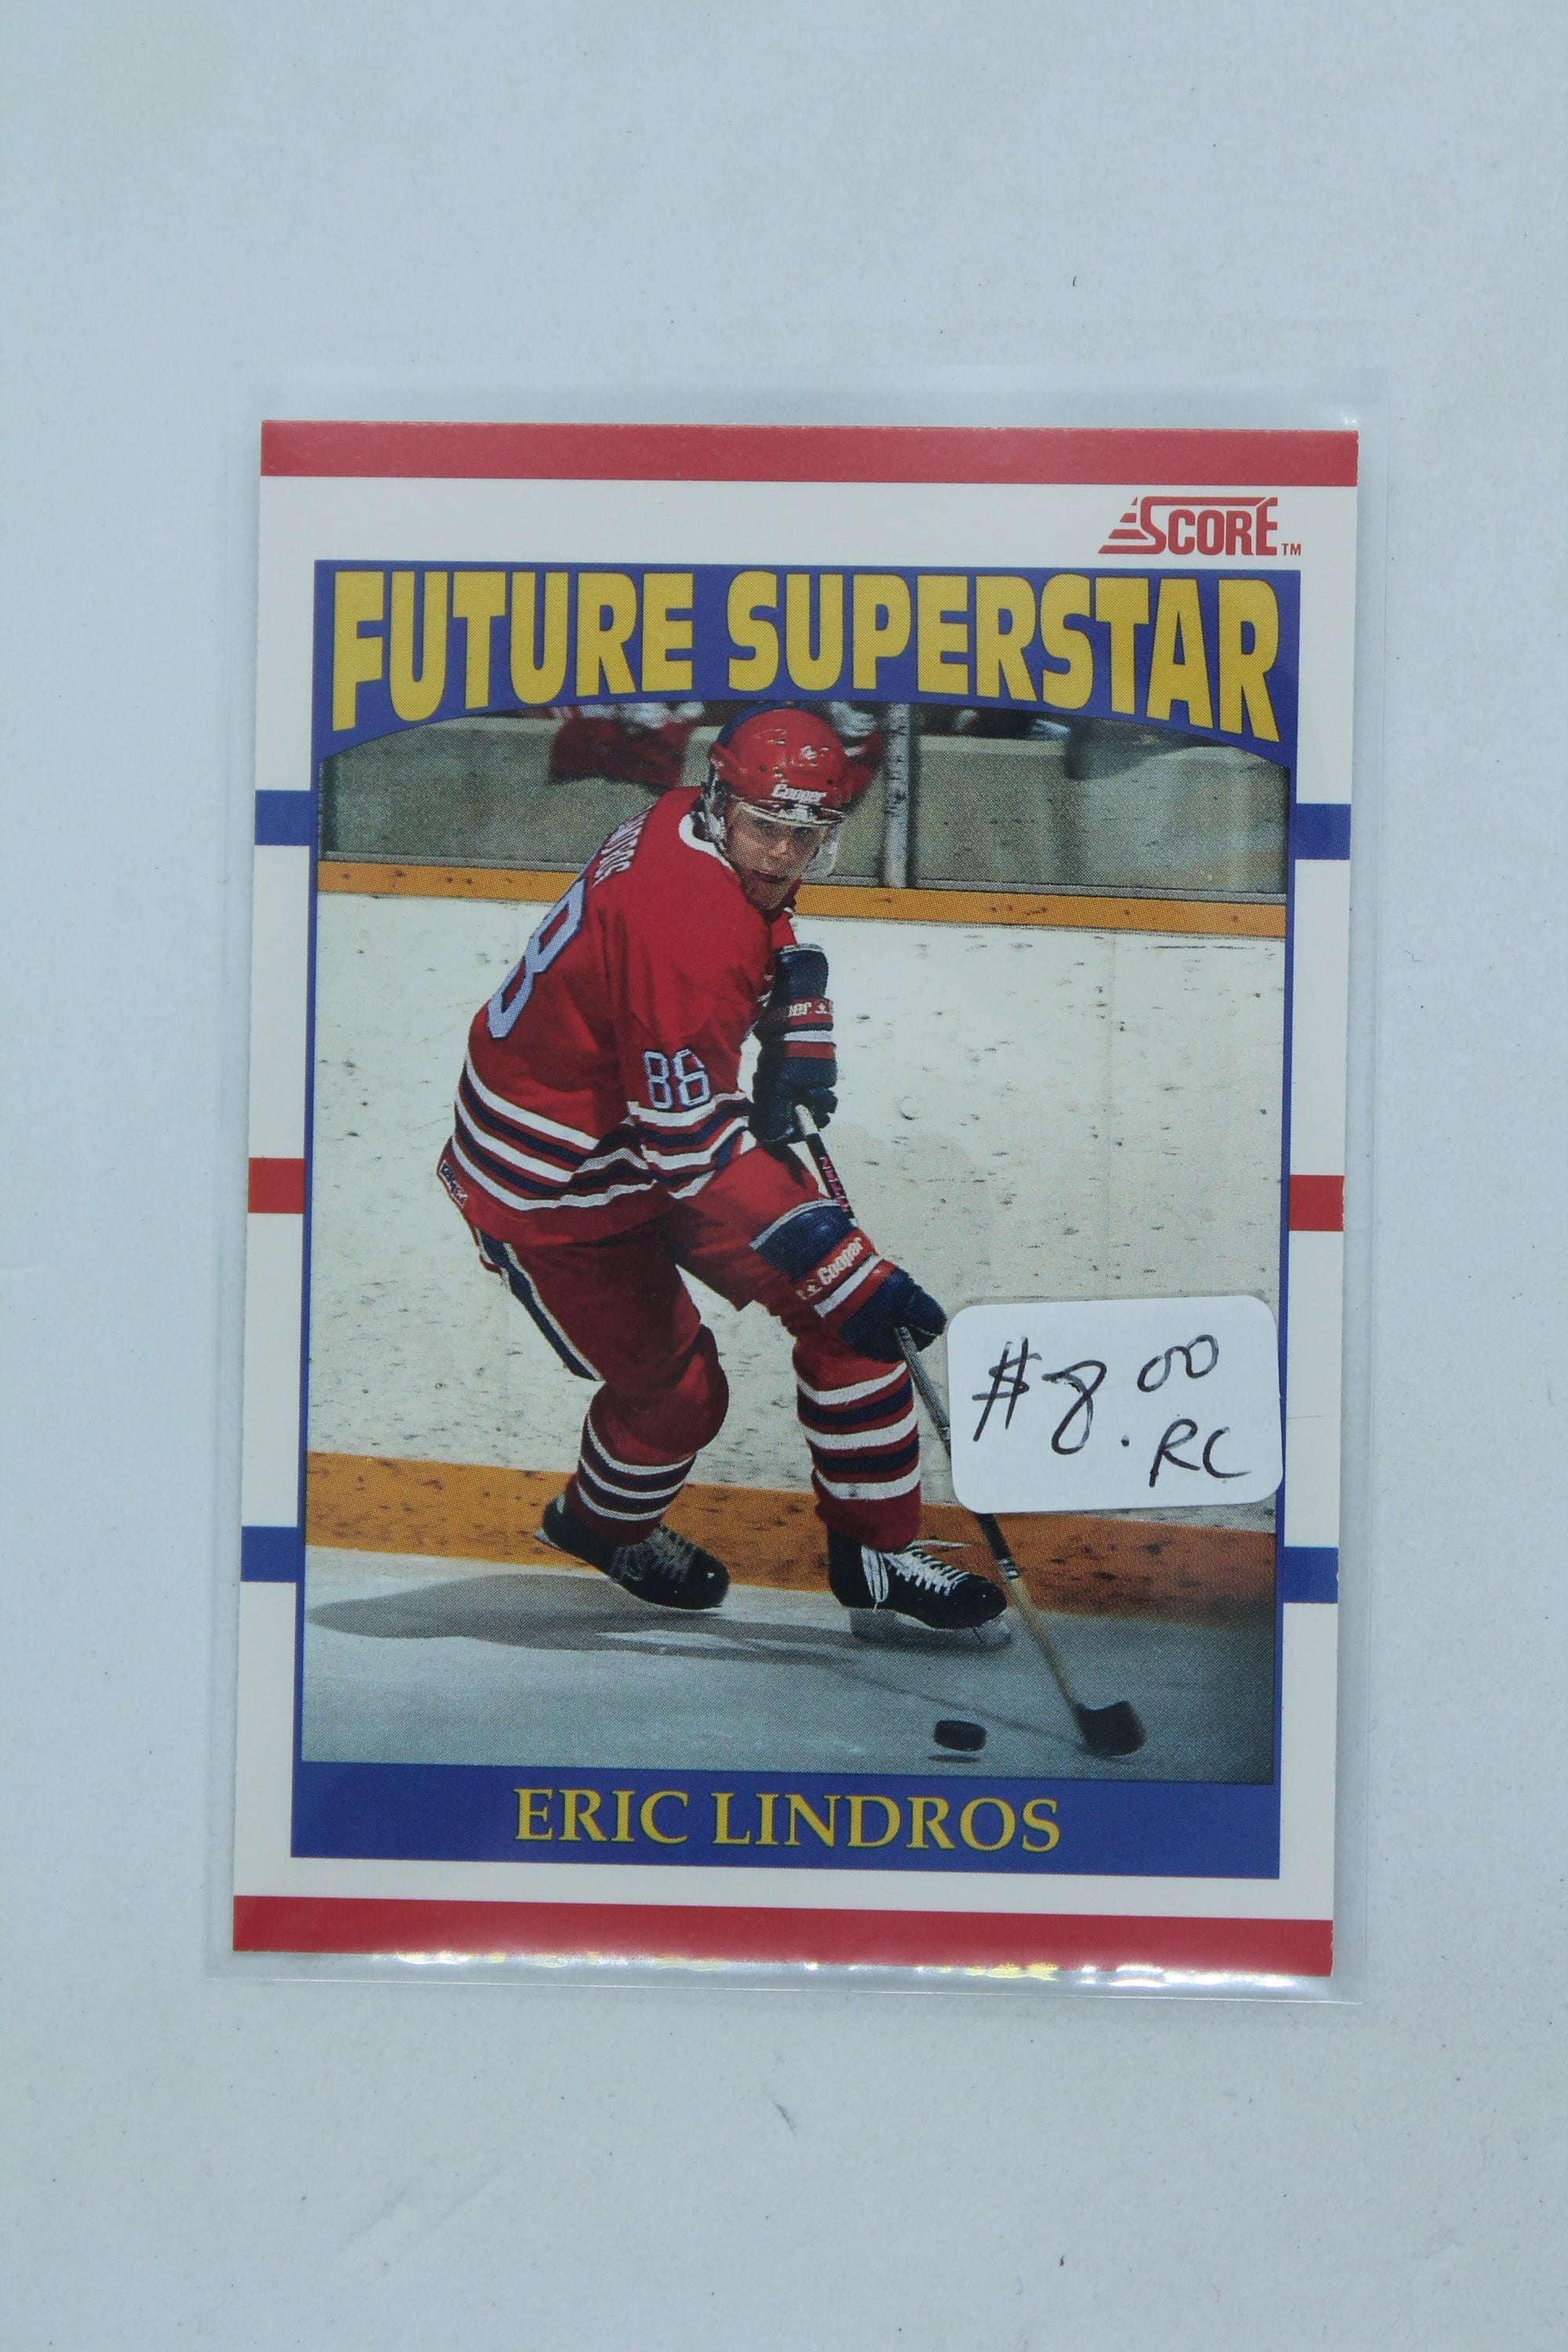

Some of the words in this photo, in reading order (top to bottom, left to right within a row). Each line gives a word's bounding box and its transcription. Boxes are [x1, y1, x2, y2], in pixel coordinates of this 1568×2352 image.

[1098, 495, 1278, 556] SCORE
[1281, 543, 1301, 556] TM
[331, 569, 695, 733] FUTURE
[725, 571, 1280, 742] SUPERSTAR
[1149, 1418, 1252, 1488] RC
[513, 1788, 690, 1844] ERIC
[710, 1791, 1062, 1853] LINDROS
